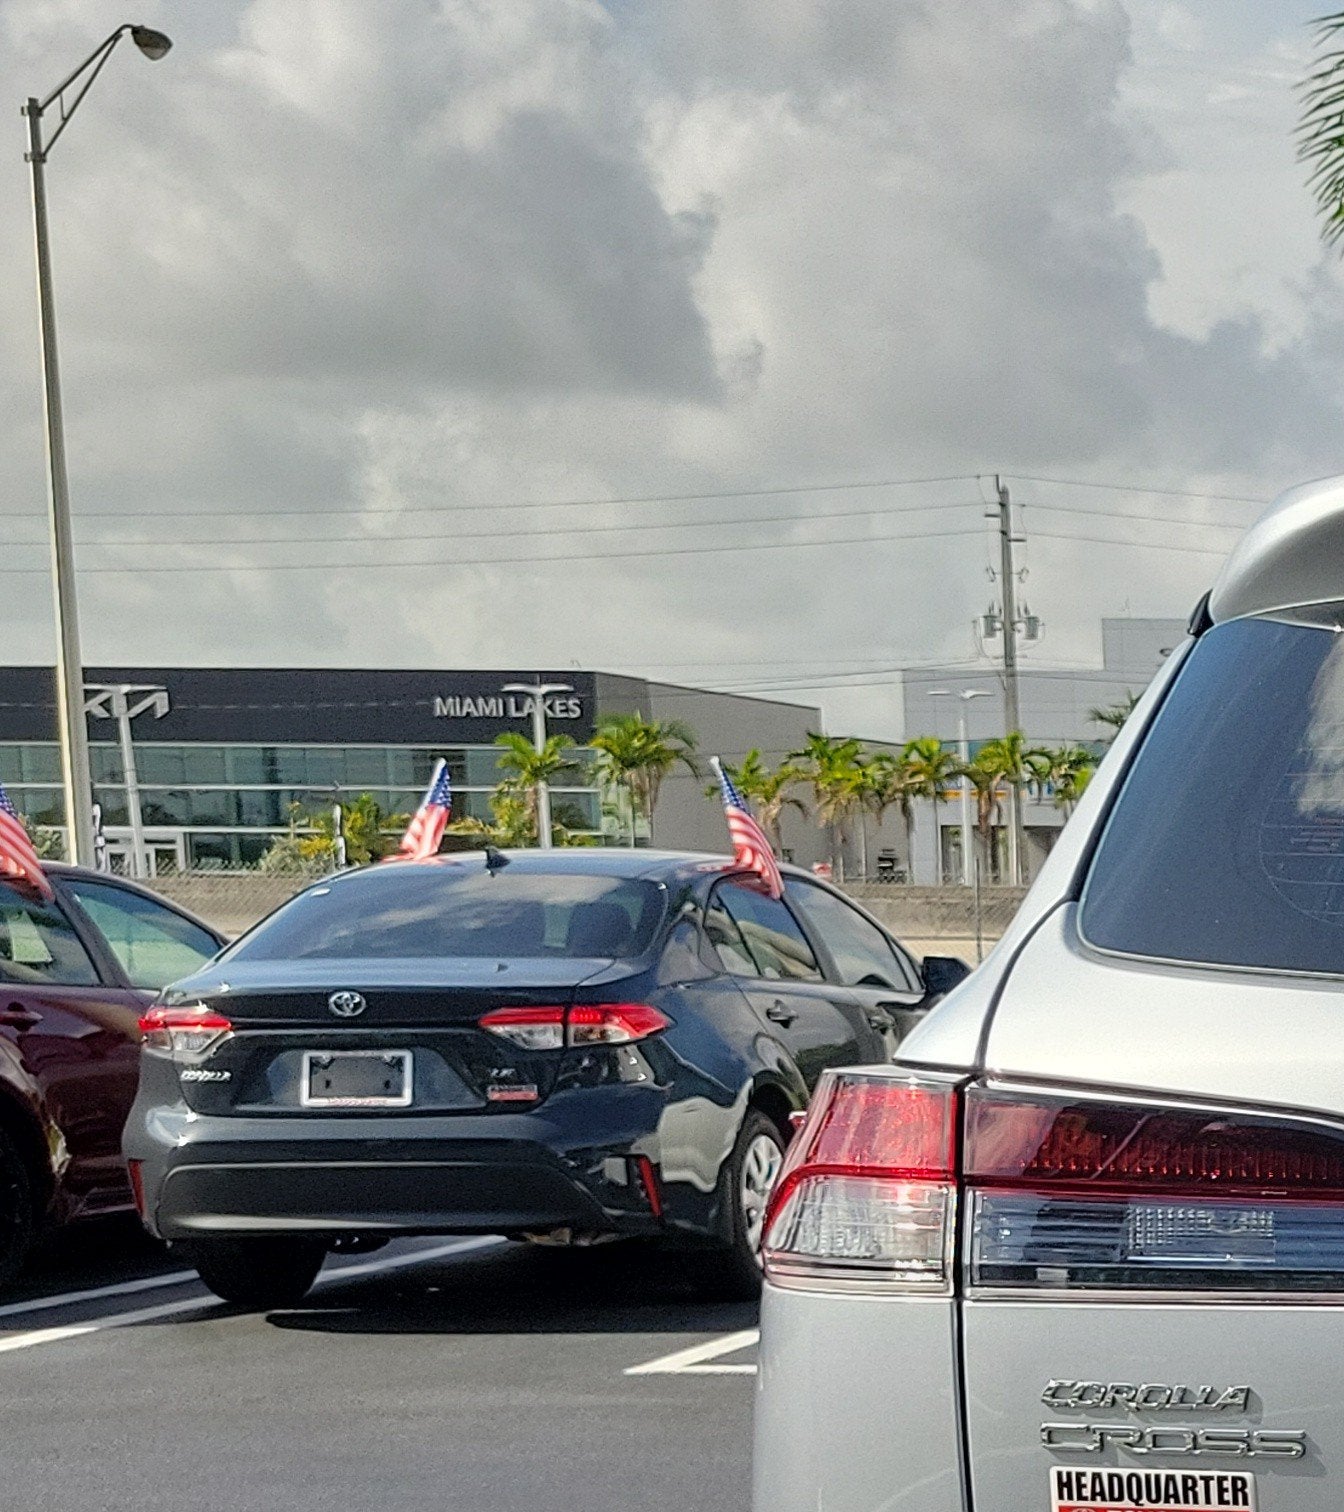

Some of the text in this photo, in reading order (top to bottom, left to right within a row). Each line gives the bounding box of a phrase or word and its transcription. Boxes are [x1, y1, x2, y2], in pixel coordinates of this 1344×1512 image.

[434, 696, 581, 718] MIAMI LAKES
[1041, 1379, 1251, 1413] COROLLA
[1040, 1422, 1306, 1459] CROSS
[1055, 1471, 1250, 1506] HEADQUARTER
